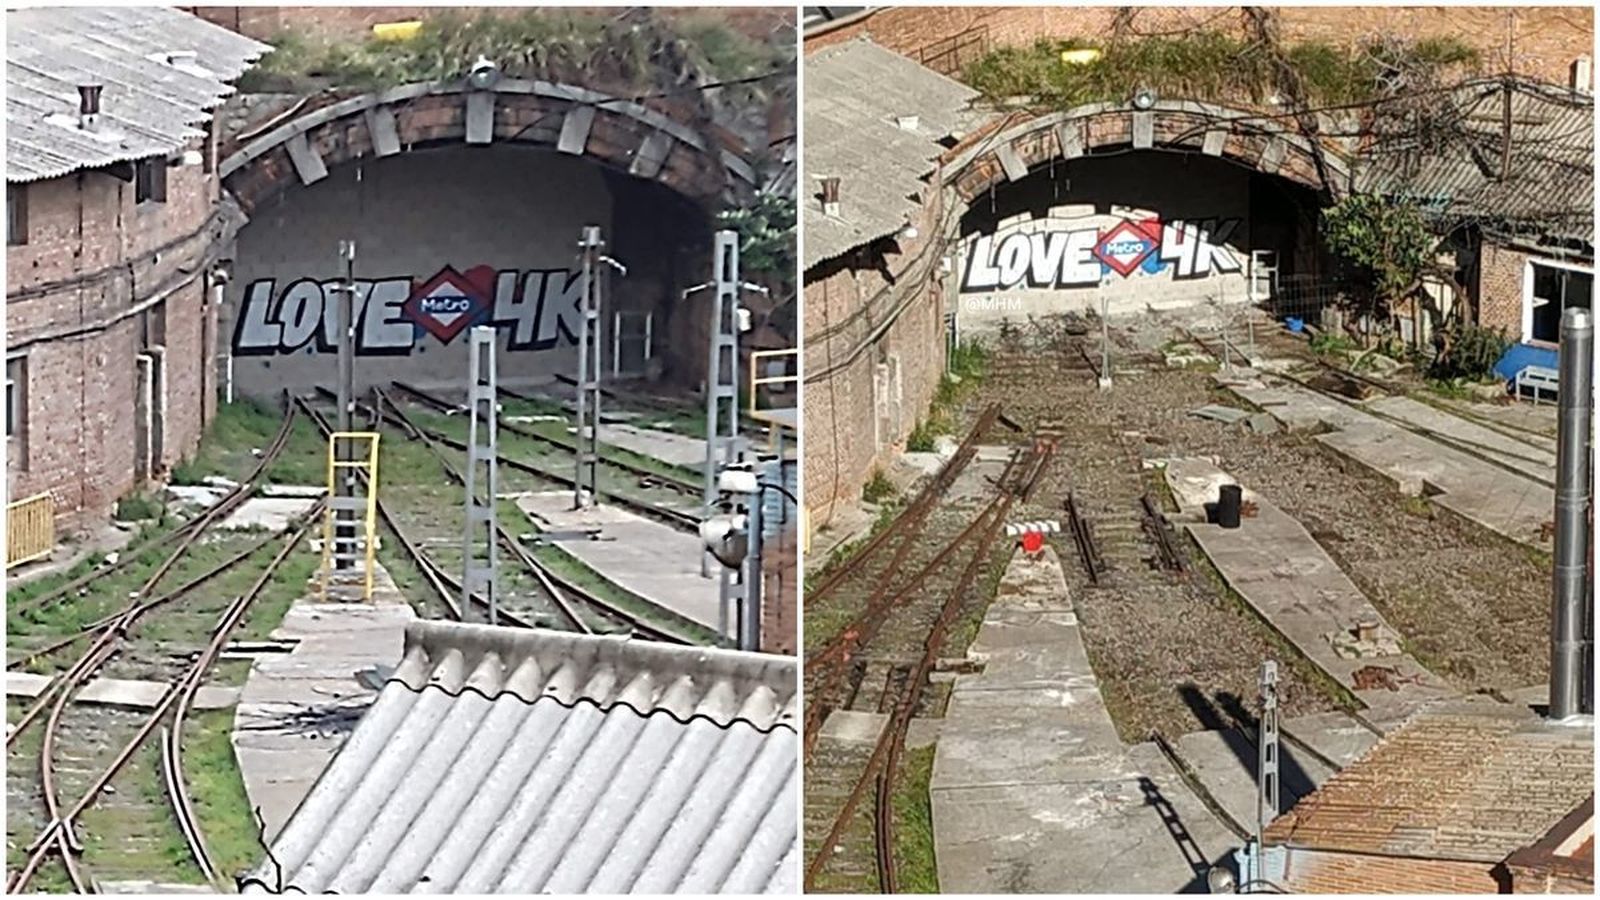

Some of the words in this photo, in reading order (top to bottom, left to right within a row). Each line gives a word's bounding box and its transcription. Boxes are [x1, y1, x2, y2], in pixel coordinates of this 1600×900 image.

[961, 228, 1101, 293] LOVE
[1106, 242, 1144, 255] Metro
[232, 277, 414, 356] LOVE
[421, 298, 470, 312] Metro
